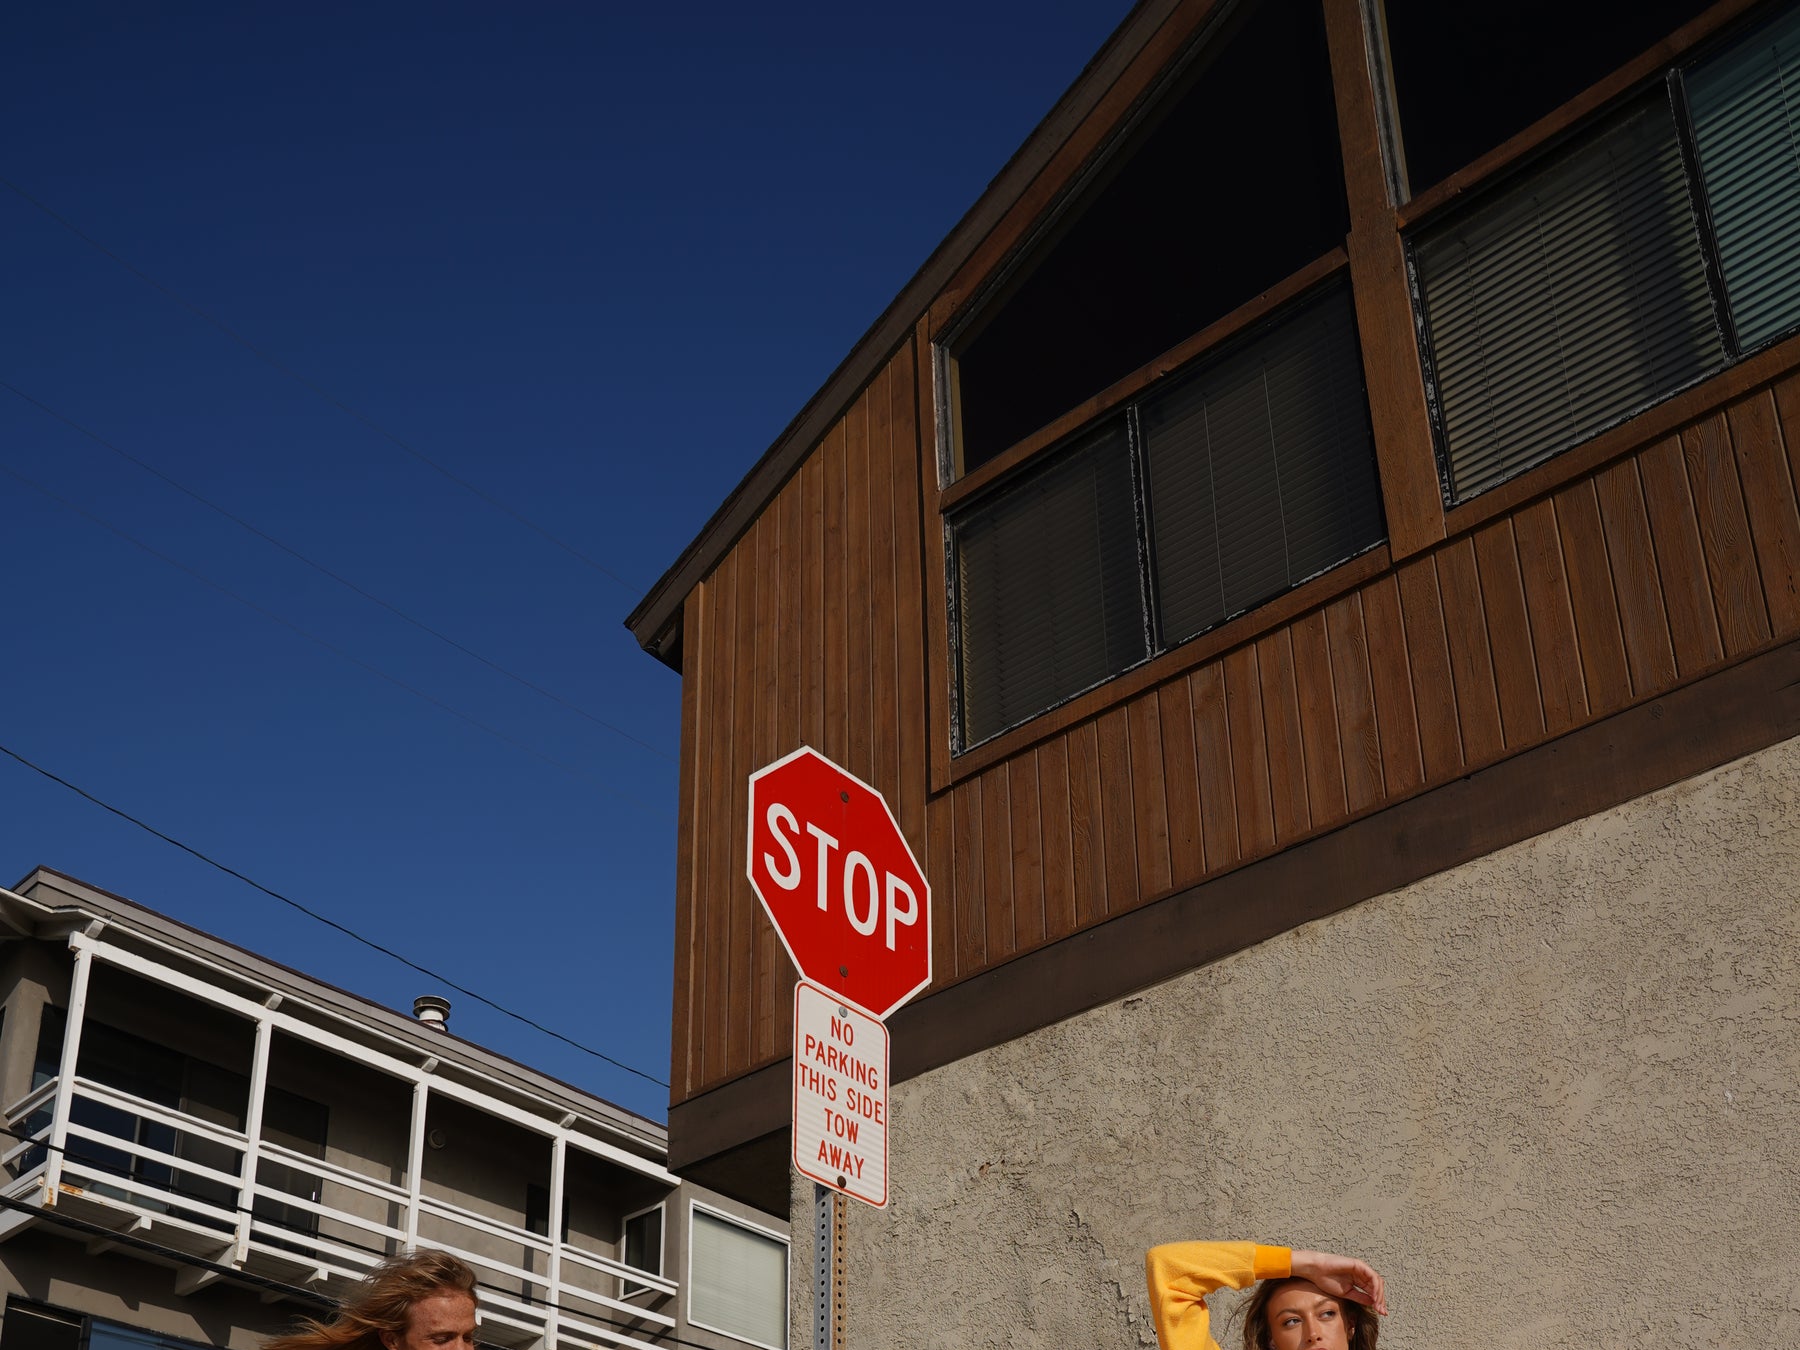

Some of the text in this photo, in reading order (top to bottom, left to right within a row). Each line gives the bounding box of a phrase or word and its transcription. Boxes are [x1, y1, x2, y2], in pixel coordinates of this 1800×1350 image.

[764, 802, 919, 952] STOP
[830, 1015, 854, 1047] NO
[805, 1033, 878, 1090] PARKING
[799, 1062, 884, 1125] THIS SIDE
[824, 1107, 859, 1144] TOW
[817, 1139, 865, 1179] AWAY
